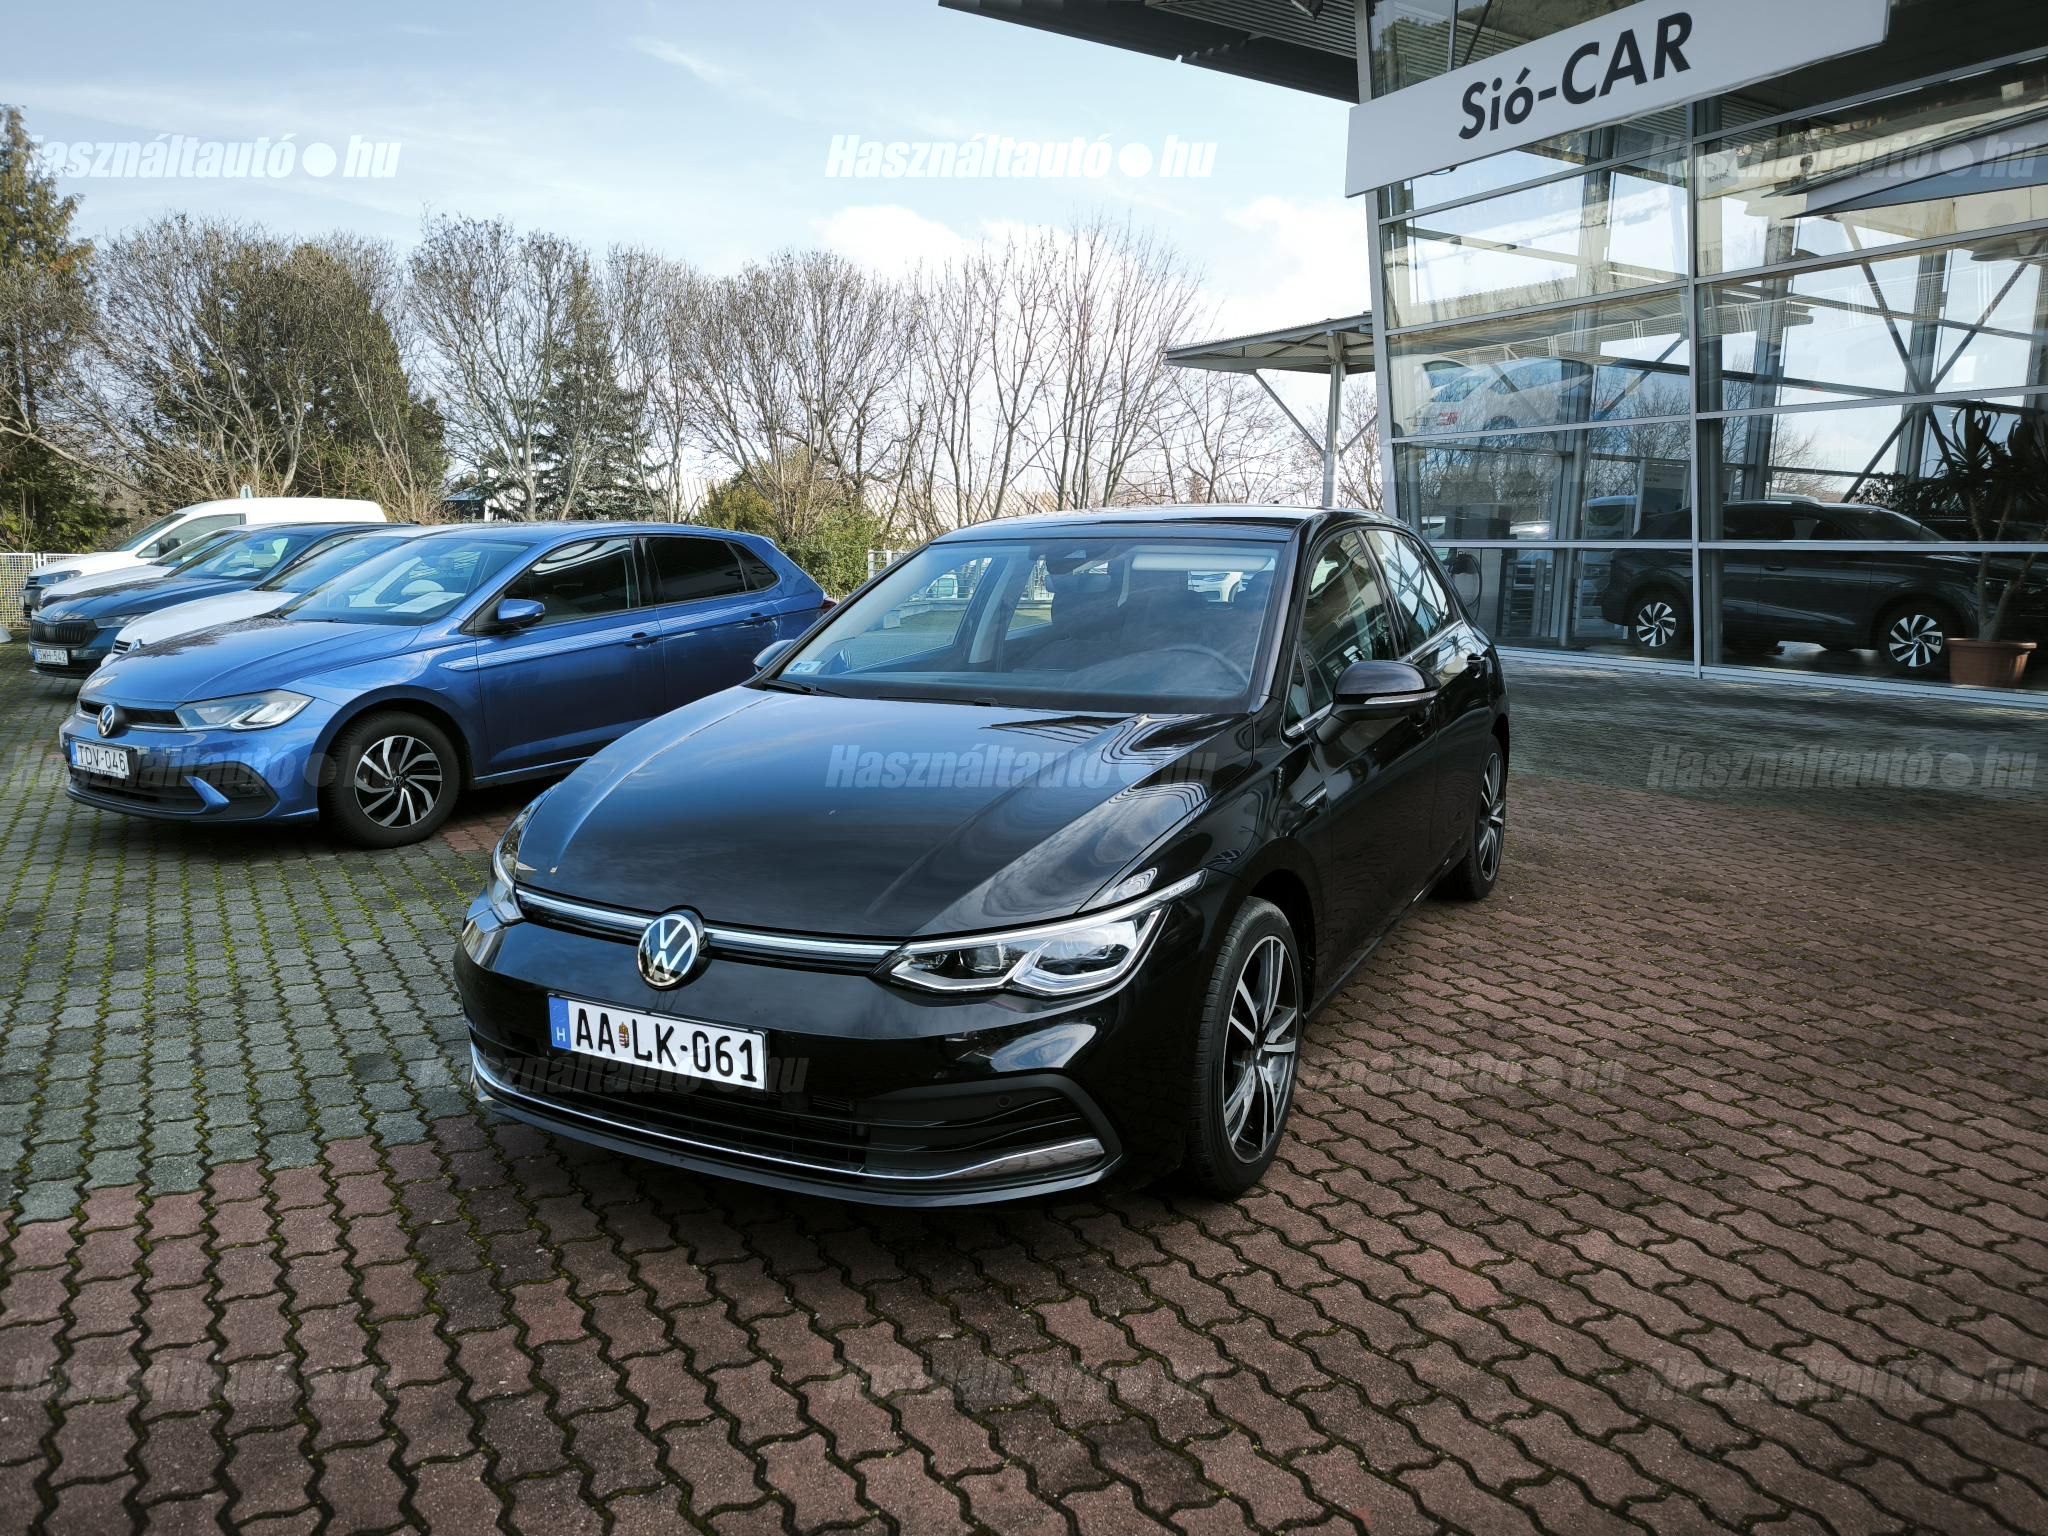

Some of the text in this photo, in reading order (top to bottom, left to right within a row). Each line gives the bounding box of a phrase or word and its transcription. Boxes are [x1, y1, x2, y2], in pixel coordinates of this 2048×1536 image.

[1458, 11, 1693, 140] Sió-CAR
[77, 744, 126, 772] TDV-046
[556, 1026, 566, 1042] H
